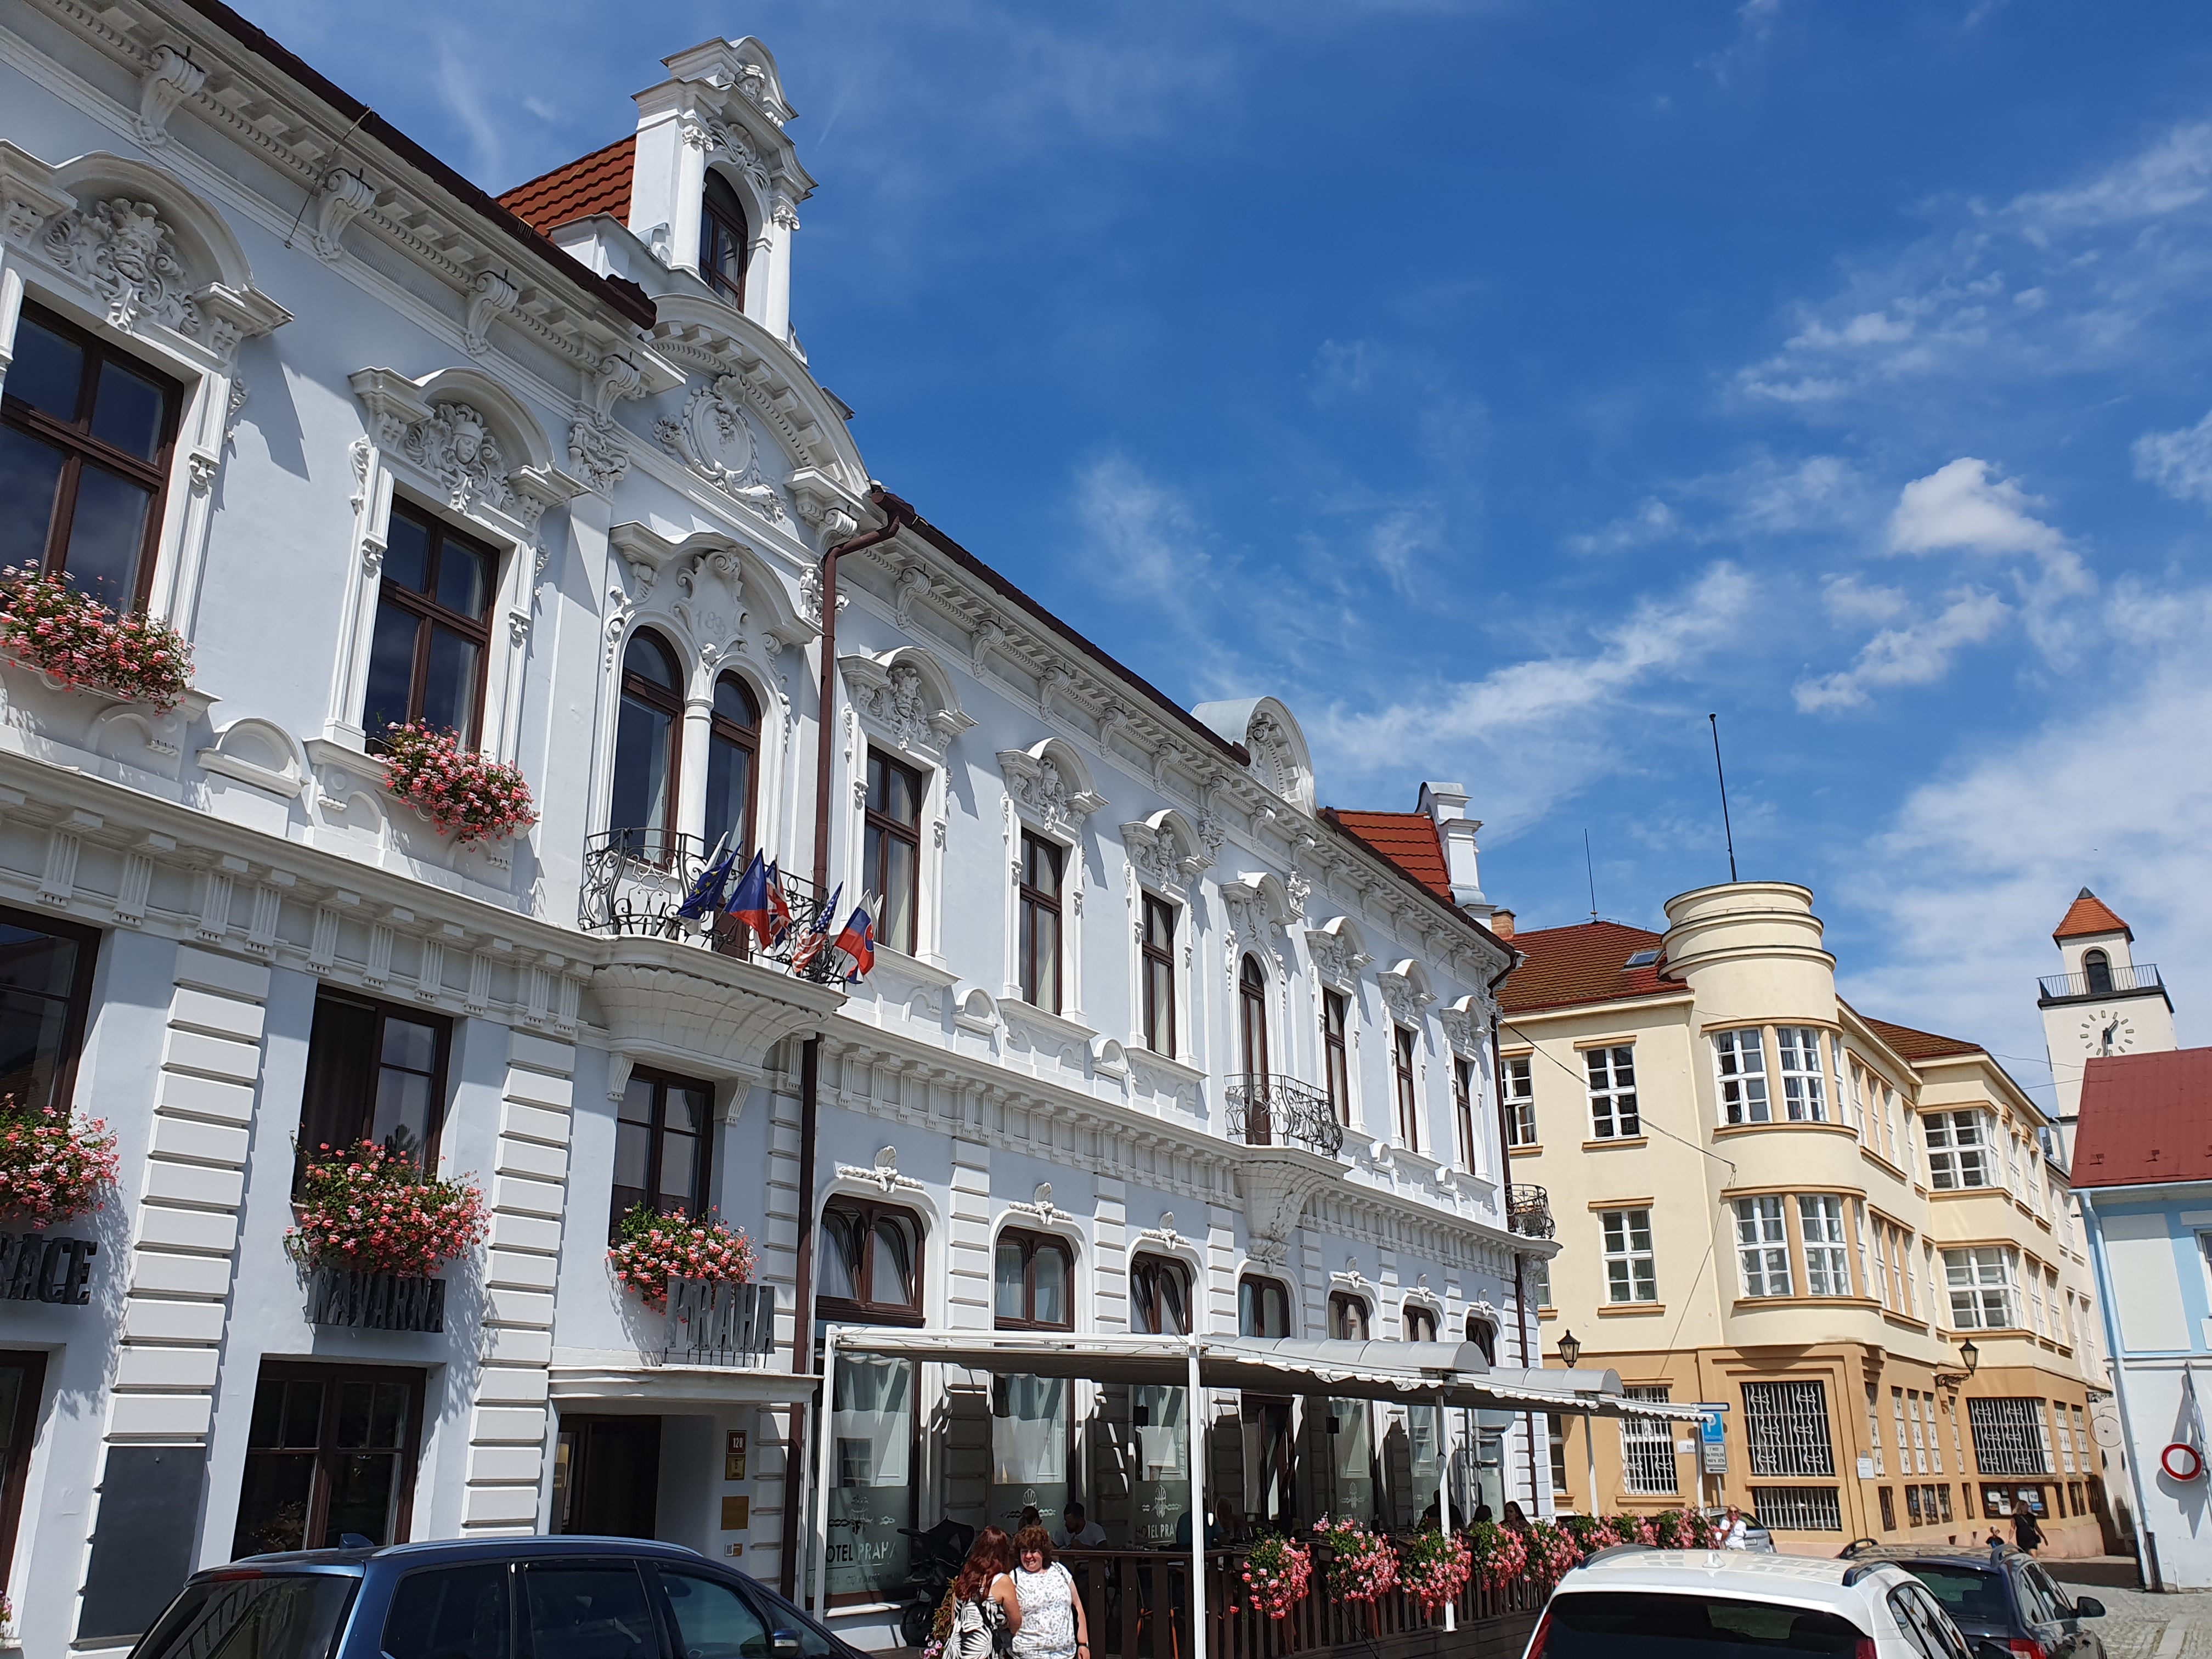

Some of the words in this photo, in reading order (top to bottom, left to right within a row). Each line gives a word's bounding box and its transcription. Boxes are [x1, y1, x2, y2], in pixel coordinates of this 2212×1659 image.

[664, 1275, 775, 1354] PRAHA
[733, 1437, 743, 1448] 128
[1160, 1523, 1177, 1538] PRA
[826, 1544, 854, 1563] OTEL
